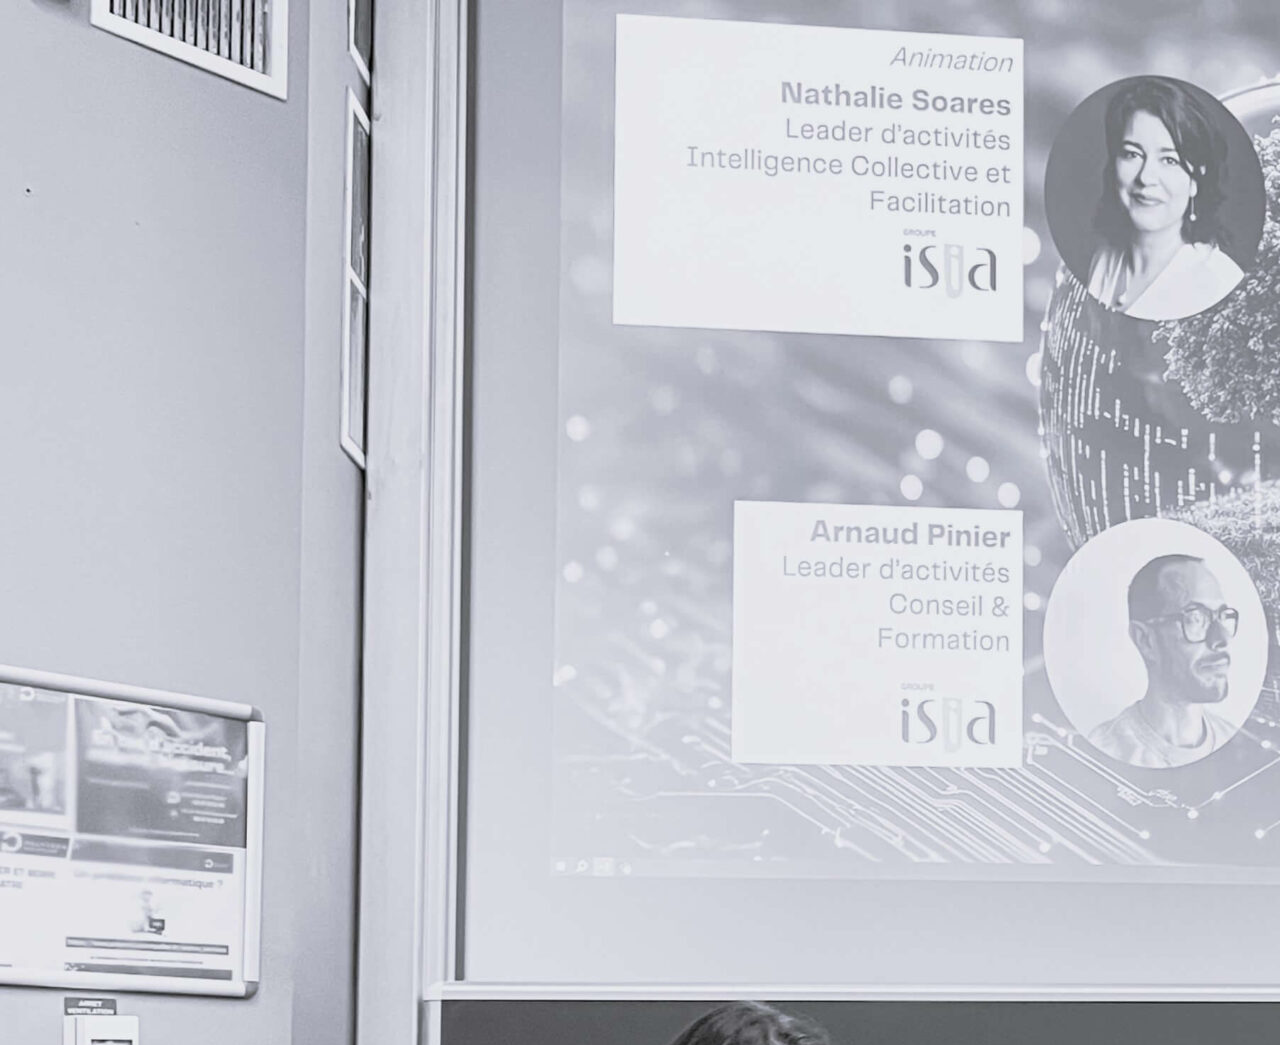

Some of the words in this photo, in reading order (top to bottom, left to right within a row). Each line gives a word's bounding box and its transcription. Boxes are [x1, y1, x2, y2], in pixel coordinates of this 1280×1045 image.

[890, 47, 1013, 72] Animation
[782, 82, 902, 109] Nathalie
[913, 89, 1010, 116] Soares
[785, 119, 872, 143] Leader
[882, 123, 1010, 150] d'activités
[688, 146, 842, 176] Intelligence
[852, 156, 978, 182] Collective
[986, 166, 1010, 183] et
[871, 191, 1010, 217] Facilitation
[811, 520, 918, 544] Arnaud
[928, 524, 1010, 548] Pinier
[783, 556, 871, 578] Leader
[880, 558, 1009, 583] d'activités
[890, 593, 982, 616] Conseil
[992, 596, 1009, 617] &
[879, 628, 1009, 651] Formation
